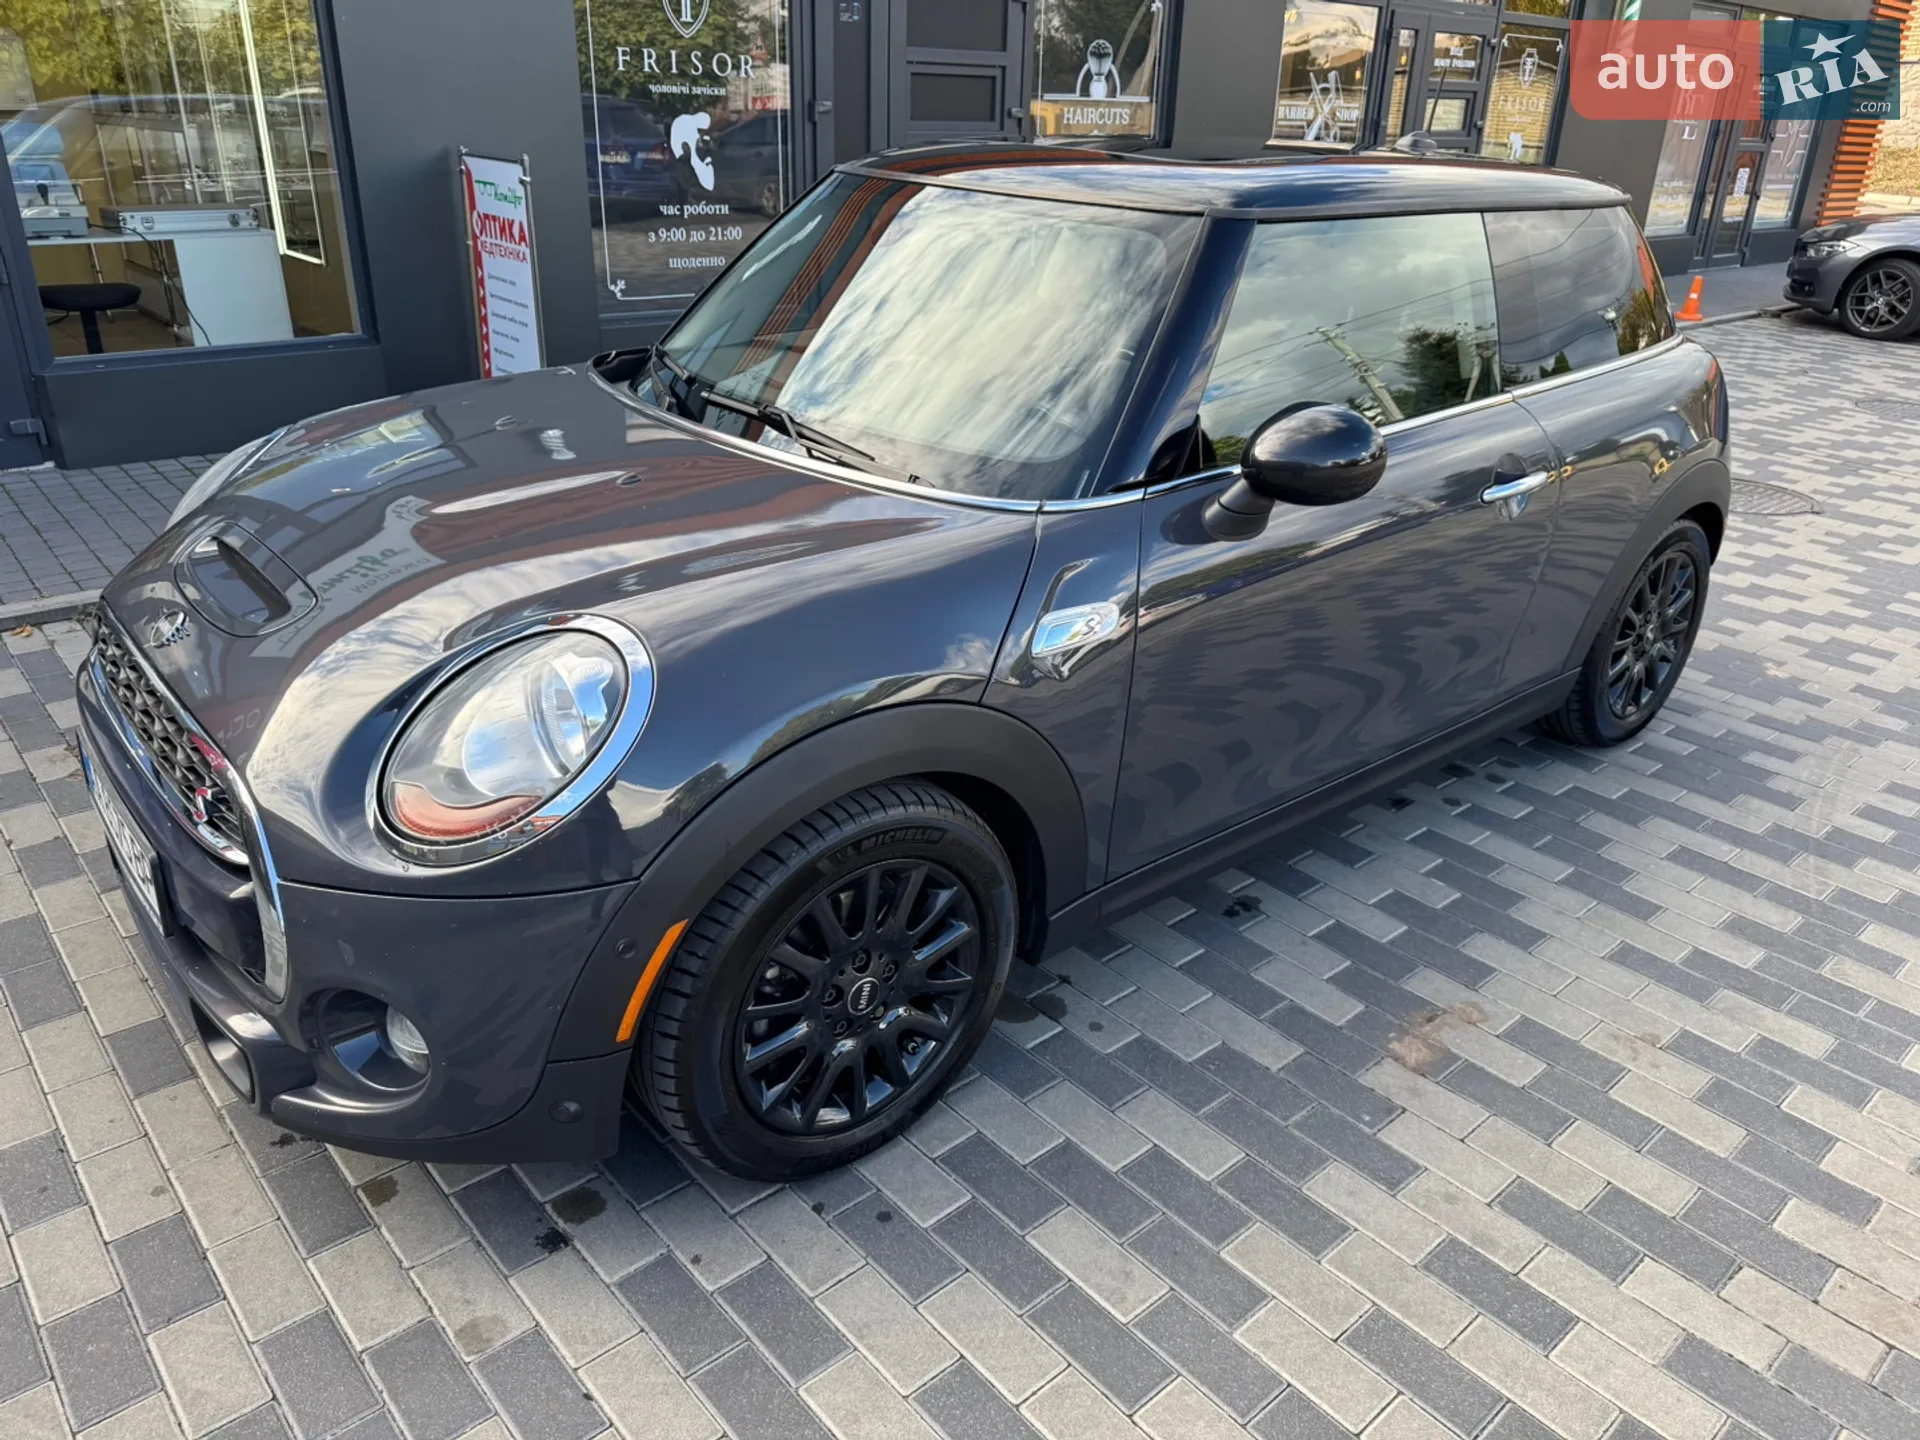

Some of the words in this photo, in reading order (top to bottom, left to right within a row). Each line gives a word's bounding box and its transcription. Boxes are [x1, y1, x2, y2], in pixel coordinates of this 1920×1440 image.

[616, 46, 756, 79] FRISOR
[649, 82, 690, 96] чоловічі
[691, 84, 726, 96] зачіски
[1063, 107, 1130, 125] HAIRCUTS
[1278, 106, 1315, 120] BARBER
[659, 204, 681, 216] час
[683, 200, 730, 219] роботи
[472, 209, 529, 248] ОПТИКА
[647, 231, 656, 243] з
[658, 227, 687, 243] 9:00
[689, 230, 706, 243] до
[708, 226, 743, 241] 21:00
[669, 256, 726, 271] щоденно
[857, 827, 948, 853] MICHELIN
[857, 983, 872, 1010] MINI
